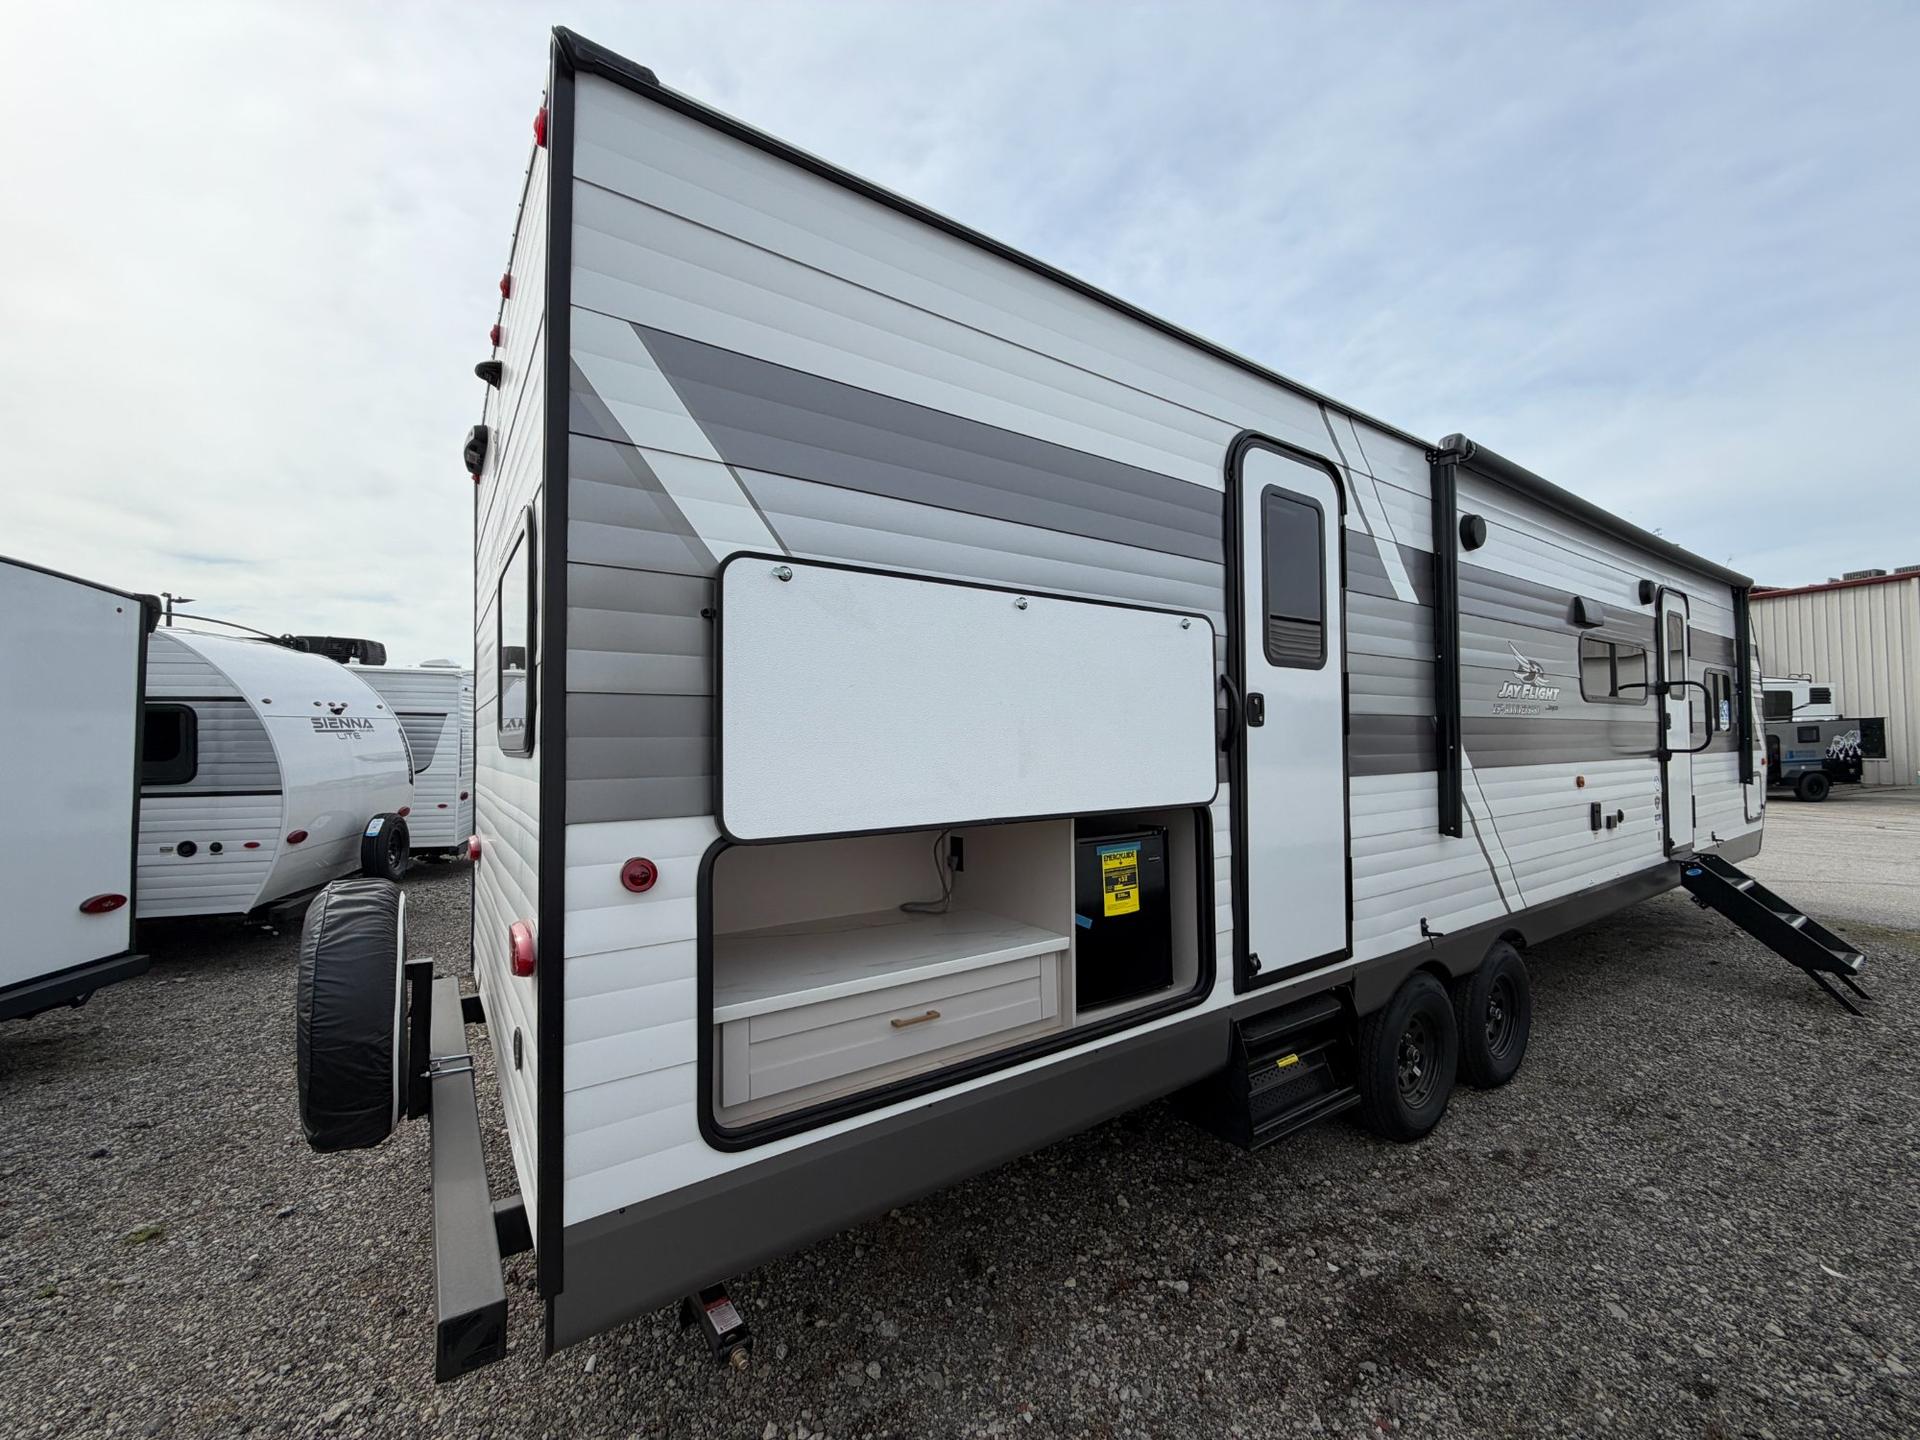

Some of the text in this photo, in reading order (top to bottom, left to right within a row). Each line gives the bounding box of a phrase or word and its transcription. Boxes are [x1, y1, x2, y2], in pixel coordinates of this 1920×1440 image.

[1498, 681, 1560, 701] JAY FLIGHT
[310, 717, 374, 729] SIENNA
[336, 731, 361, 740] LITE
